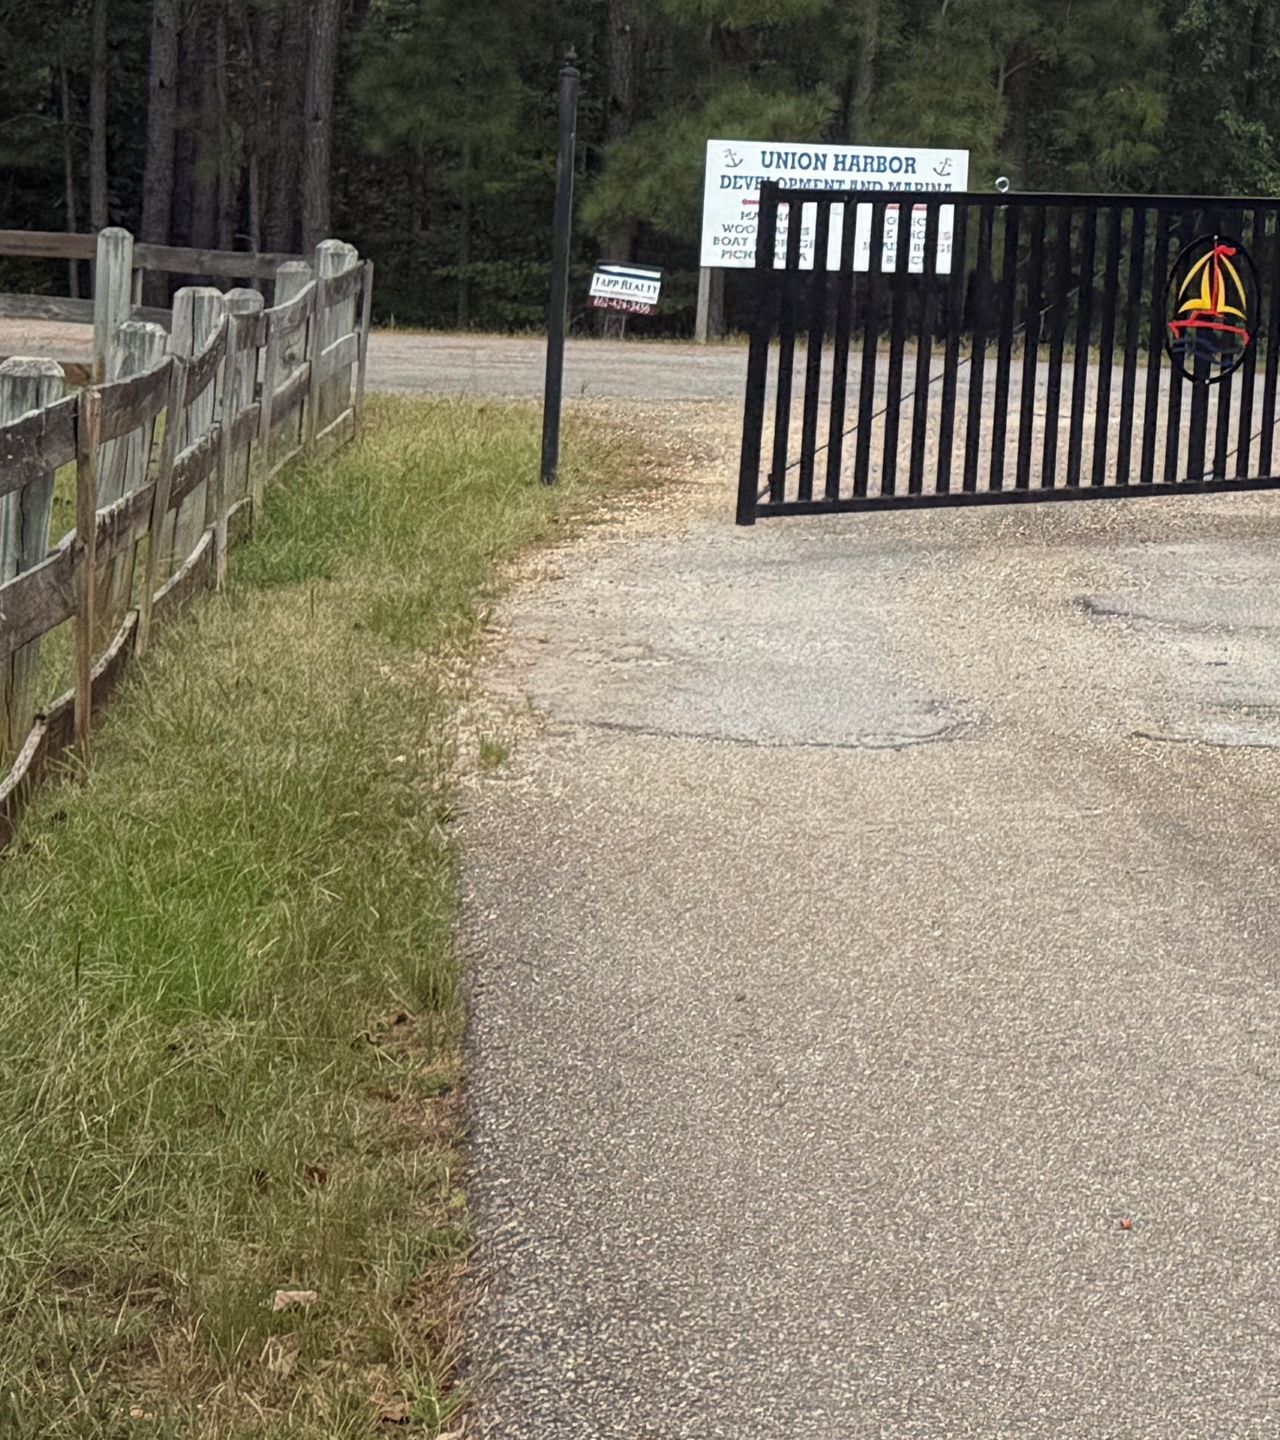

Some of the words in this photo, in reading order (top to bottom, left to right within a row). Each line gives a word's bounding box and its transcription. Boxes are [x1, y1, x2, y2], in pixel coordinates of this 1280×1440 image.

[761, 150, 827, 171] UNION
[833, 153, 917, 174] HARBOR
[712, 236, 749, 246] BOAT
